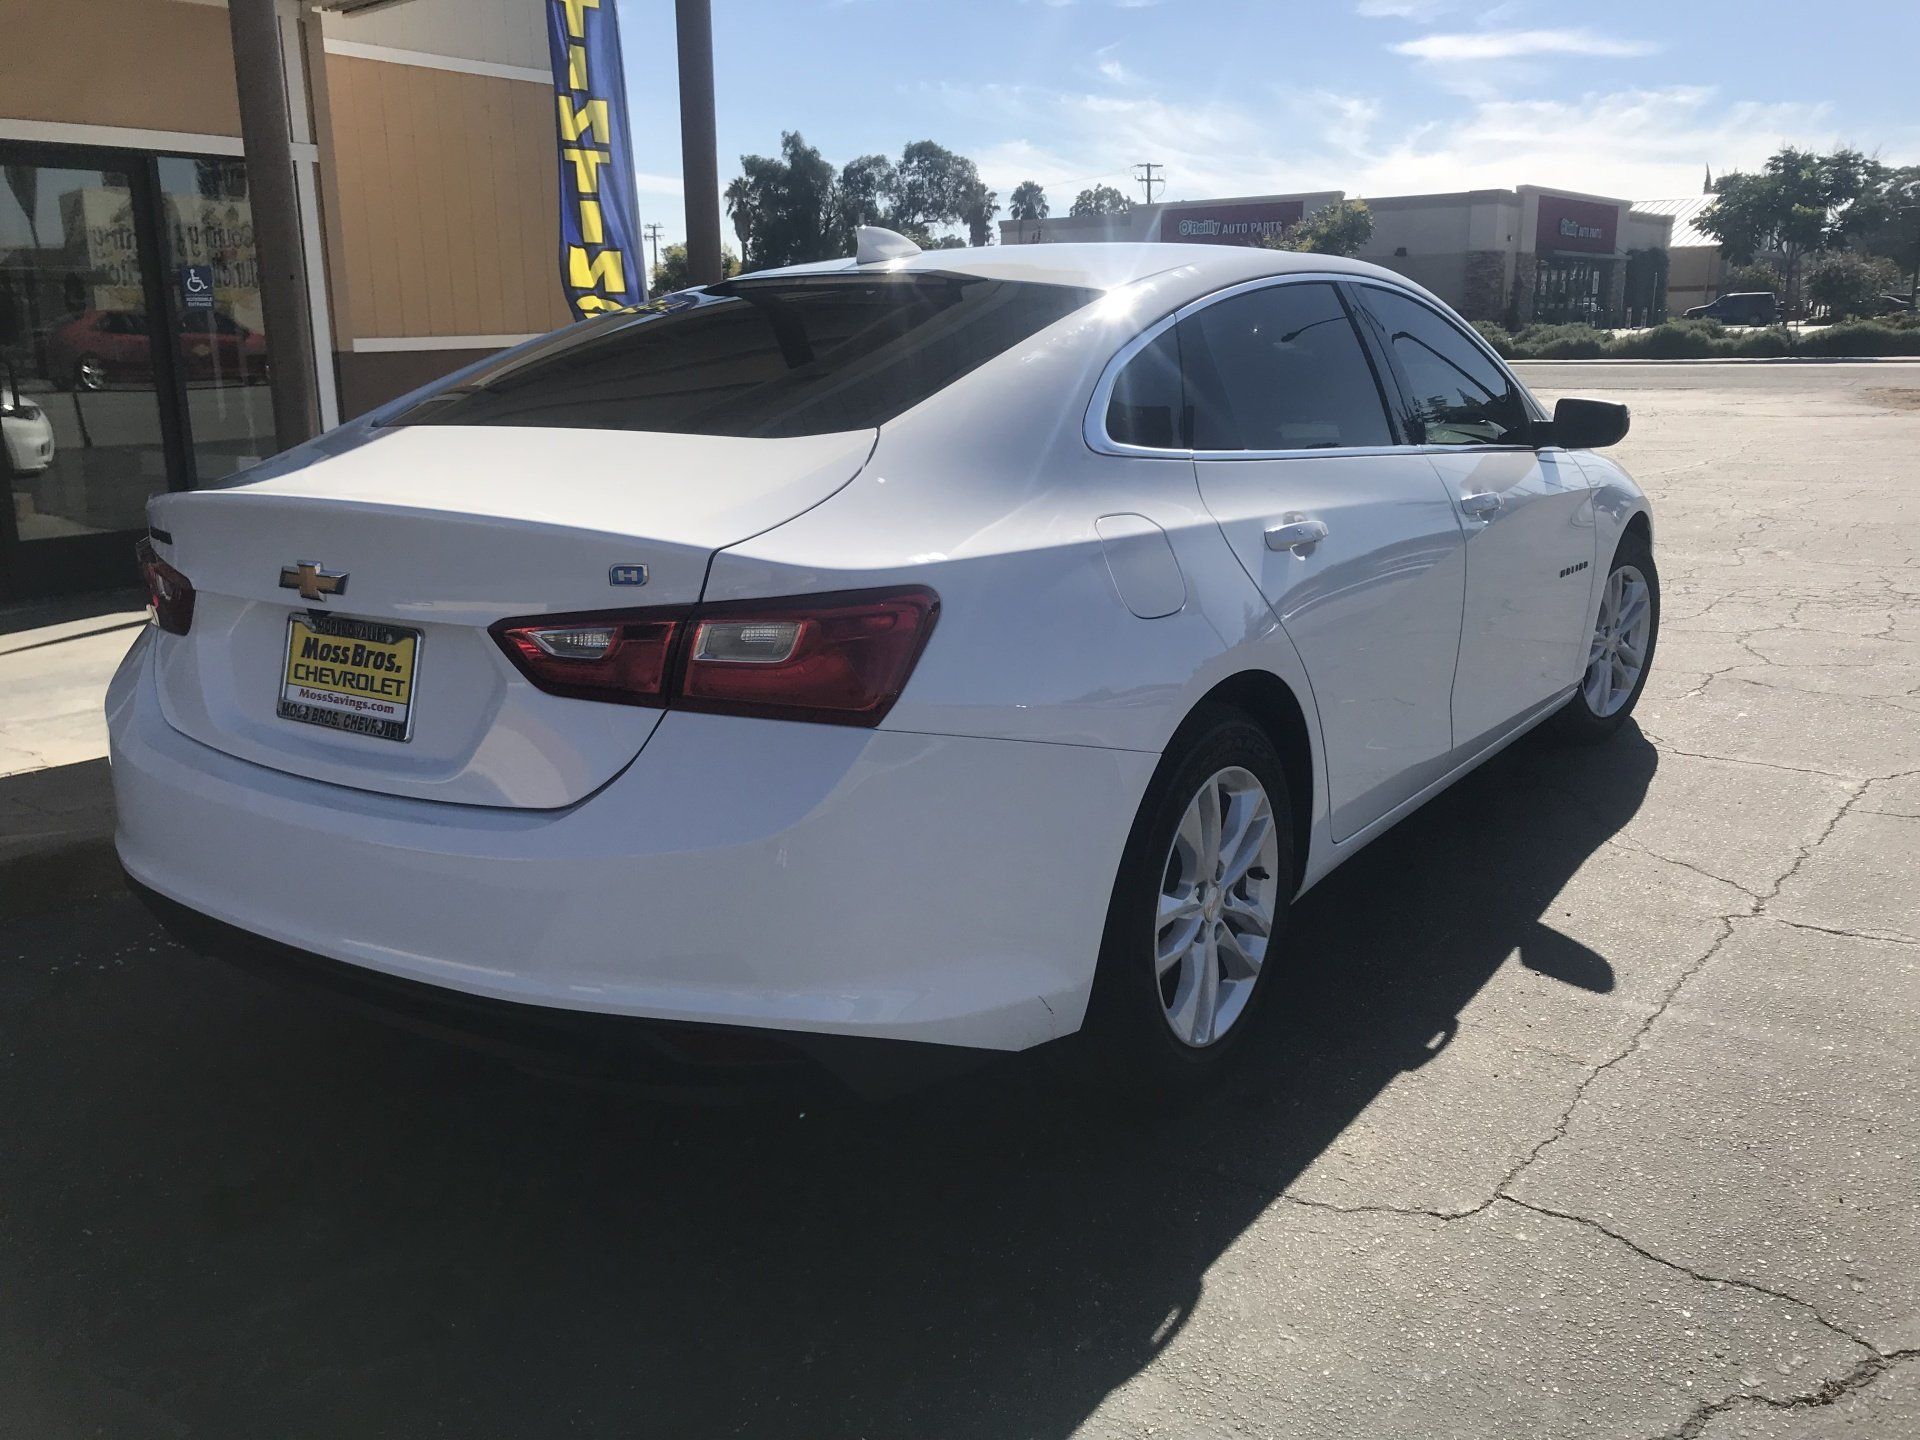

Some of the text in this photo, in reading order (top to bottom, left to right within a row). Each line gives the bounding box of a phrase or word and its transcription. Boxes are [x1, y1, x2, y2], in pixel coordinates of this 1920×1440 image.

[1179, 220, 1282, 235] O'Reilly AUTO PARTS
[617, 569, 638, 582] H
[301, 637, 402, 673] Moss Bros.
[294, 663, 405, 696] CHEVROLET
[299, 688, 395, 714] MossSavings.com
